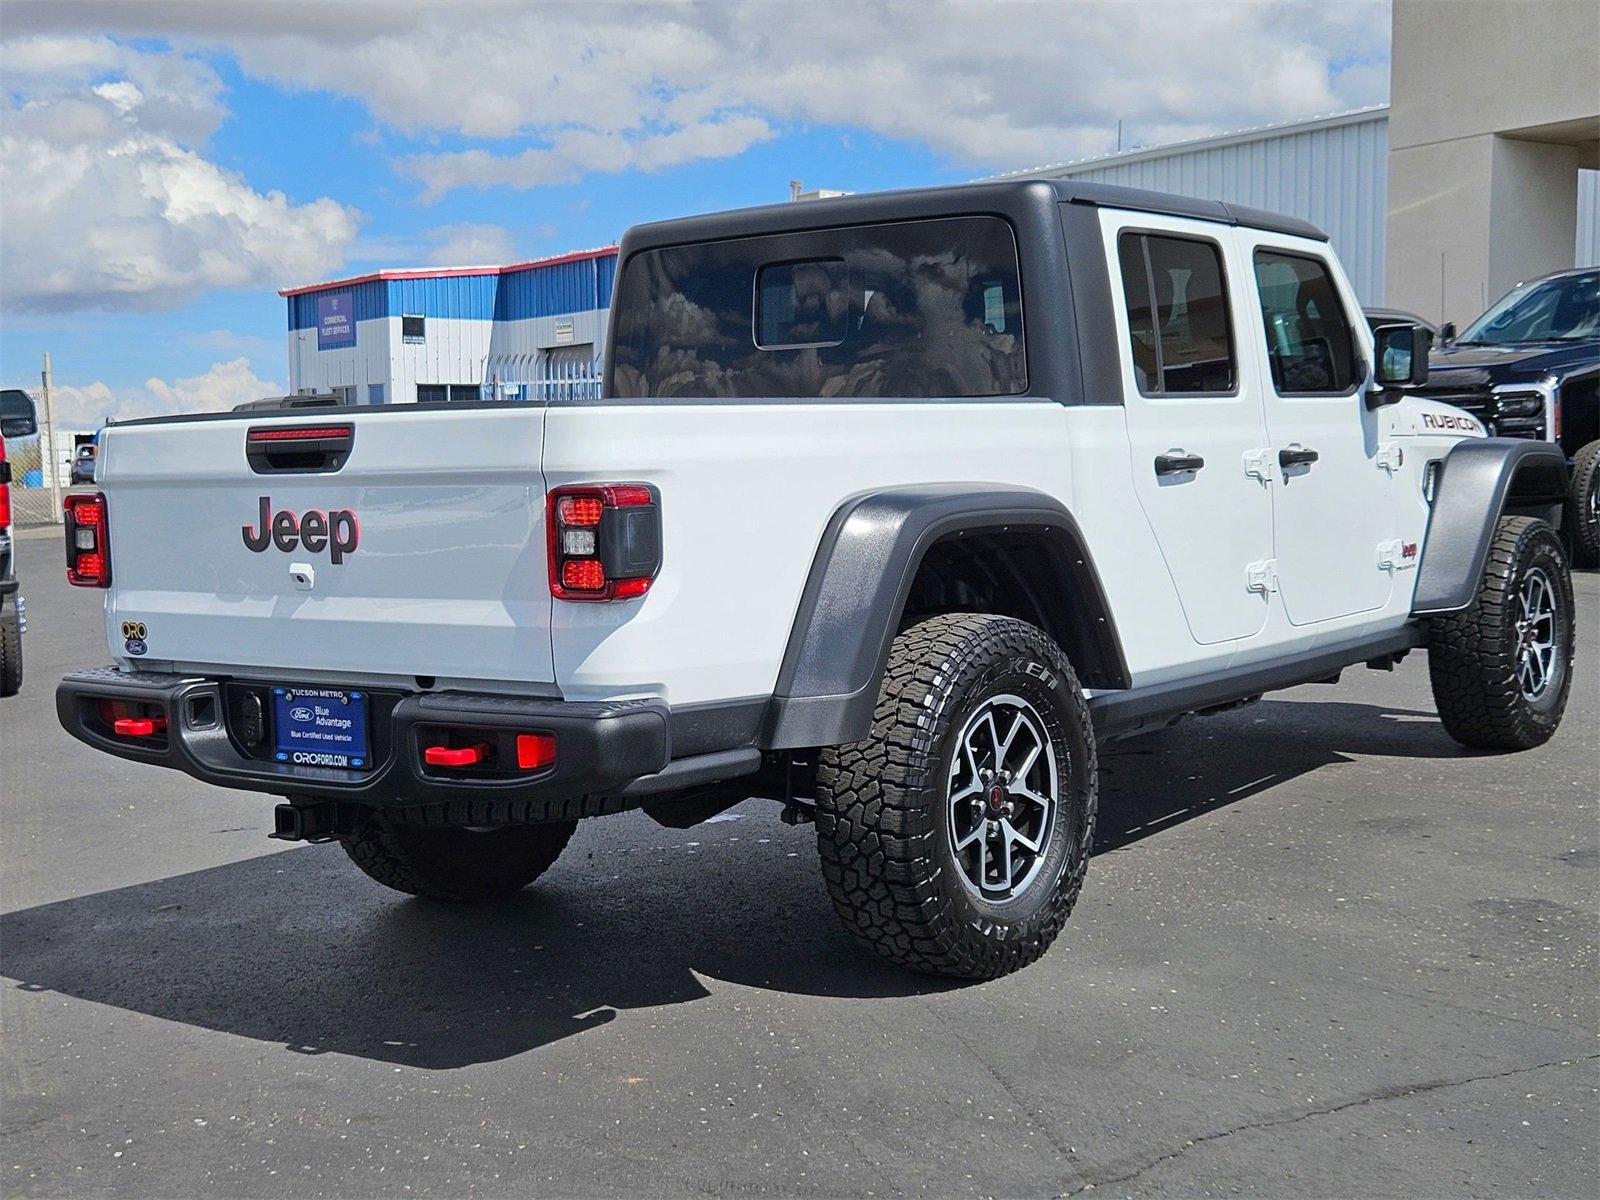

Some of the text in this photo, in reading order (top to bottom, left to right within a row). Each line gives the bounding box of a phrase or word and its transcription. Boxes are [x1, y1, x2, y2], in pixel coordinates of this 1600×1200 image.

[324, 315, 348, 325] COMMERCIAL
[322, 325, 350, 336] FLEET SERVICES
[1421, 413, 1482, 433] RUBICON
[242, 496, 359, 565] Jeep
[122, 622, 147, 639] ORO
[127, 641, 145, 653] Ford
[291, 689, 318, 697] TUCSON
[320, 690, 343, 698] METRO
[292, 708, 312, 720] Ford
[315, 706, 330, 716] Blue
[316, 717, 352, 729] Advantage
[302, 731, 321, 739] Certified
[334, 734, 352, 742] Vehicle
[293, 752, 348, 767] OROFORD.COM
